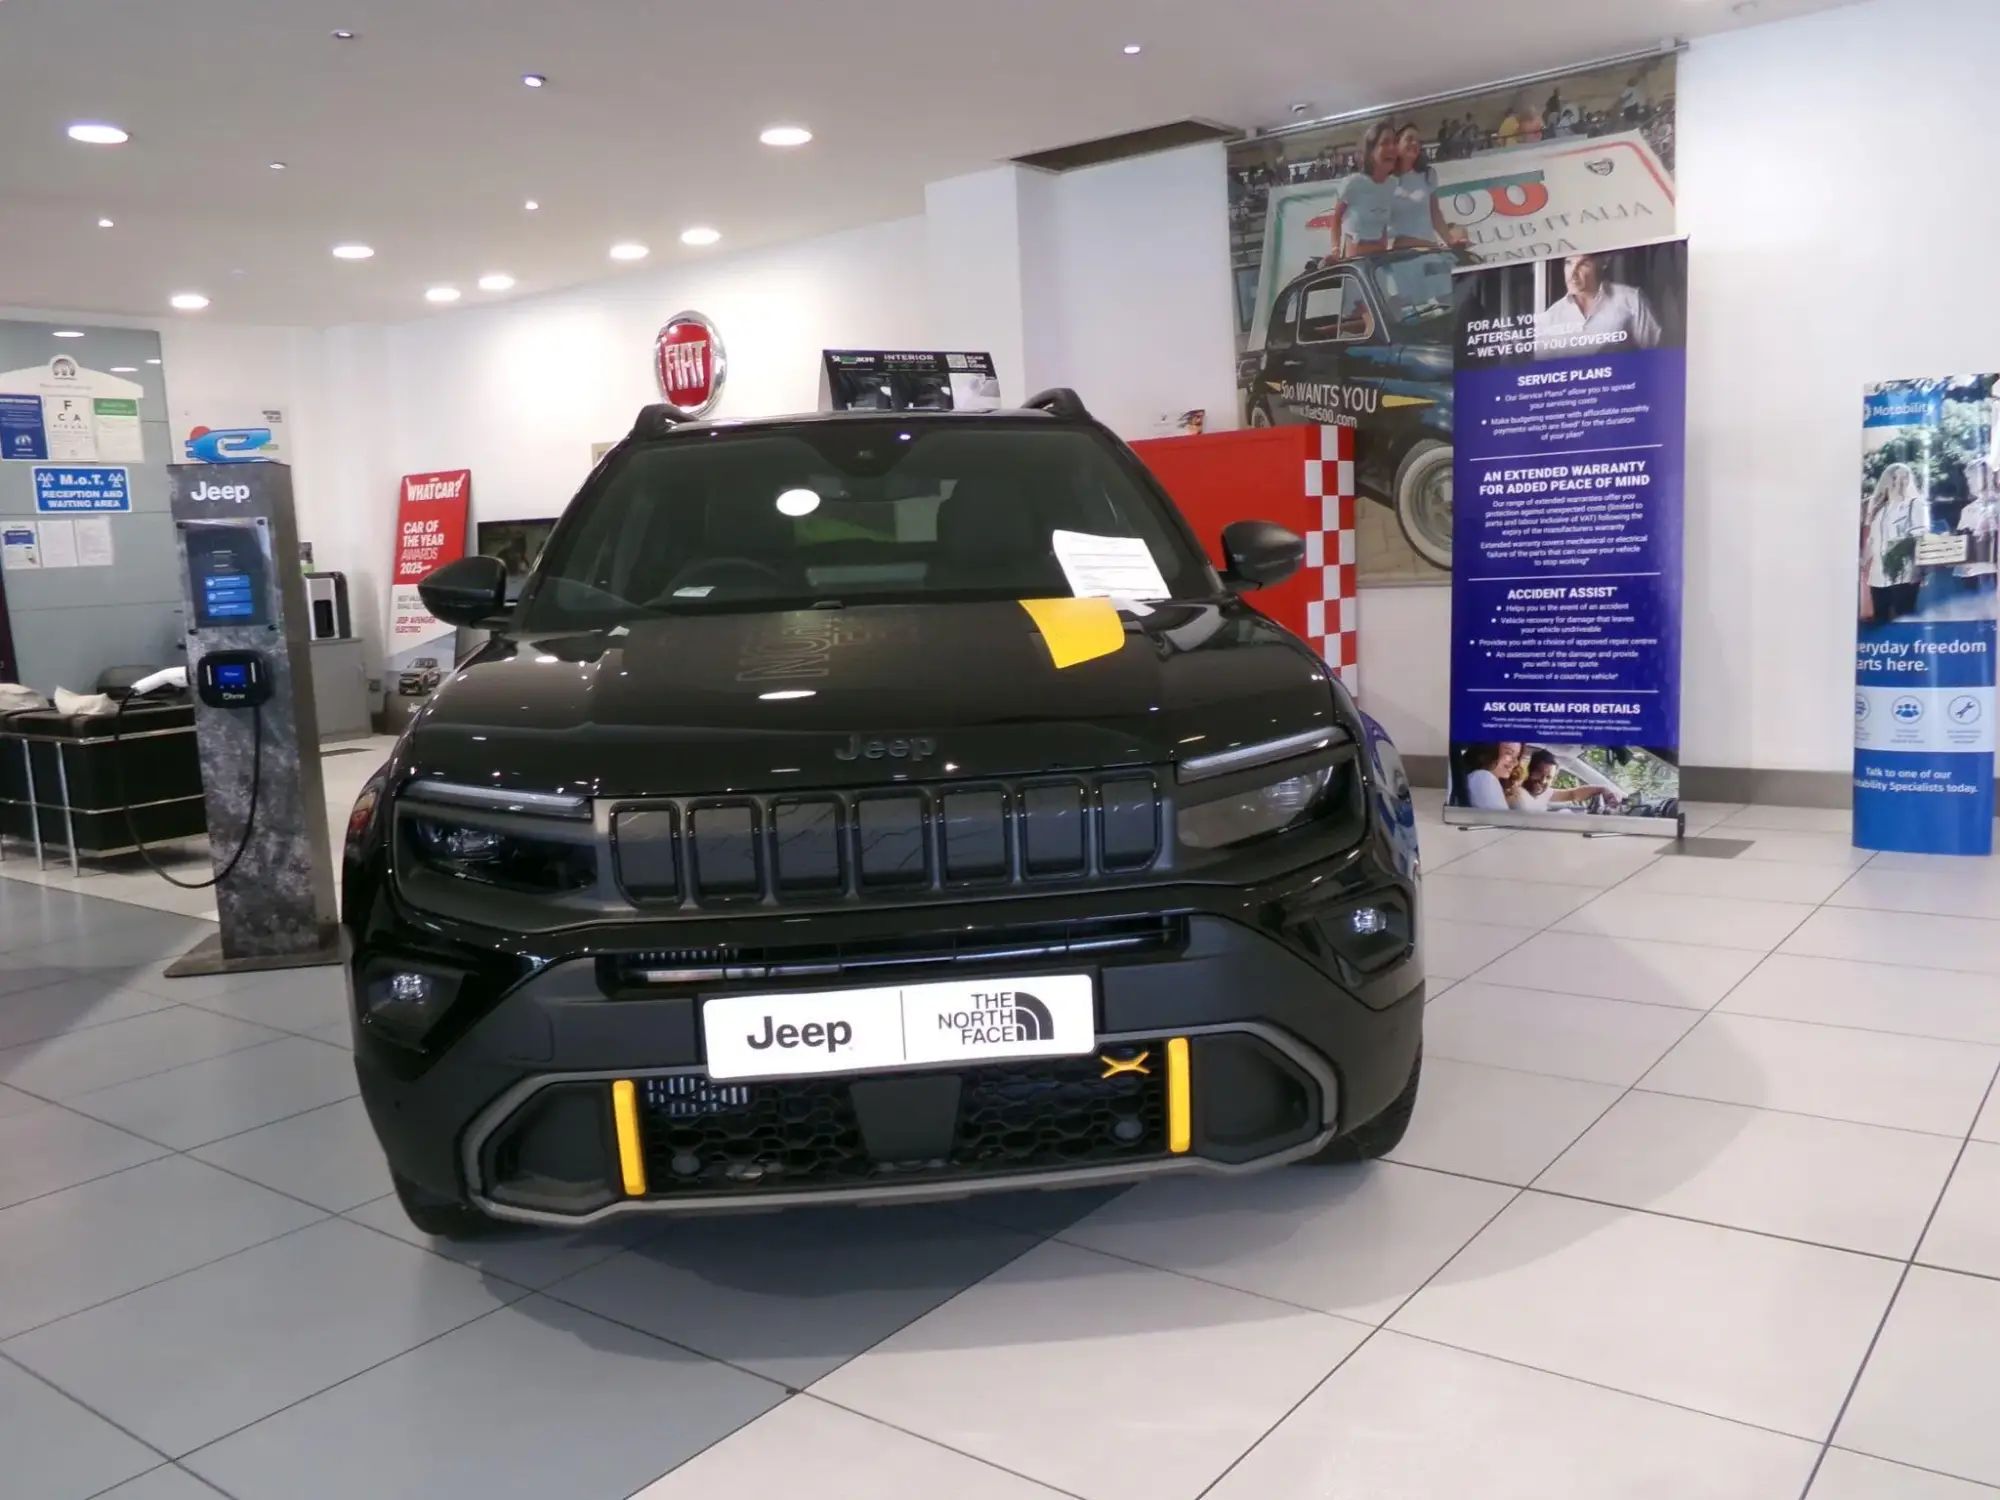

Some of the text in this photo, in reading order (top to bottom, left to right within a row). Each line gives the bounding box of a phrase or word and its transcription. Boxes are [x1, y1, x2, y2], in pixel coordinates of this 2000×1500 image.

[1475, 202, 1653, 245] LUB ITALIA
[1467, 318, 1489, 332] FOR
[1491, 316, 1514, 329] ALL
[1477, 329, 1628, 358] WE'VE GOT YOU COVERED
[664, 340, 708, 392] FIAT
[1517, 366, 1612, 387] SERVICE PLANS
[1296, 382, 1340, 406] WANTS
[1342, 385, 1378, 414] YOU
[1518, 391, 1542, 400] Service
[1567, 386, 1586, 396] allow
[1588, 387, 1600, 395] you
[1611, 381, 1635, 393] spread
[64, 400, 72, 411] F
[1529, 397, 1598, 411] your servicing costs
[57, 413, 81, 422] C A
[1490, 416, 1509, 425] Make
[1510, 413, 1544, 425] budgeting
[1566, 409, 1581, 418] with
[1582, 406, 1620, 416] affordable
[1620, 403, 1648, 414] monthly
[1493, 425, 1526, 436] payments
[1592, 417, 1604, 425] the
[1605, 415, 1634, 425] duration
[1550, 432, 1564, 440] your
[1484, 460, 1646, 483] AN EXTENDED WARRANTY
[60, 474, 105, 485] M.o.T.
[1480, 474, 1650, 496] FOR ADDED PEACE OF MIND
[41, 490, 123, 498] RECEPTION AND
[191, 482, 250, 503] Jeep
[1534, 496, 1565, 505] extended
[1604, 492, 1620, 501] offer
[1622, 493, 1636, 501] you
[47, 500, 120, 508] WAITING AREA
[403, 519, 439, 534] CAR OF
[402, 533, 445, 548] THE YEAR
[1480, 540, 1510, 549] Extended
[1512, 540, 1540, 549] warranty
[1565, 536, 1605, 545] mechanical
[1615, 533, 1646, 542] electrical
[402, 548, 439, 561] AWARDS
[1508, 587, 1566, 599] ACCIDENT
[1506, 604, 1524, 612] Helps
[1599, 602, 1628, 610] accident
[1526, 617, 1554, 625] recovery
[1566, 615, 1595, 624] damage
[1520, 627, 1536, 635] your
[1536, 626, 1560, 634] vehicle
[1575, 639, 1608, 647] approved
[1857, 639, 1987, 657] eryday freedom
[1578, 660, 1599, 668] quote
[1857, 657, 1930, 671] arts here.
[1484, 701, 1640, 714] ASK OUR TEAM FOR DETAILS
[834, 733, 937, 761] Jeep
[1865, 767, 1952, 779] Talk to one of our
[1889, 782, 1945, 793] Specialists
[1946, 782, 1978, 793] today.
[970, 991, 1013, 1010] THE
[938, 1008, 1014, 1030] NORTH
[746, 1016, 853, 1053] Jeep
[961, 1025, 1015, 1045] FACE
